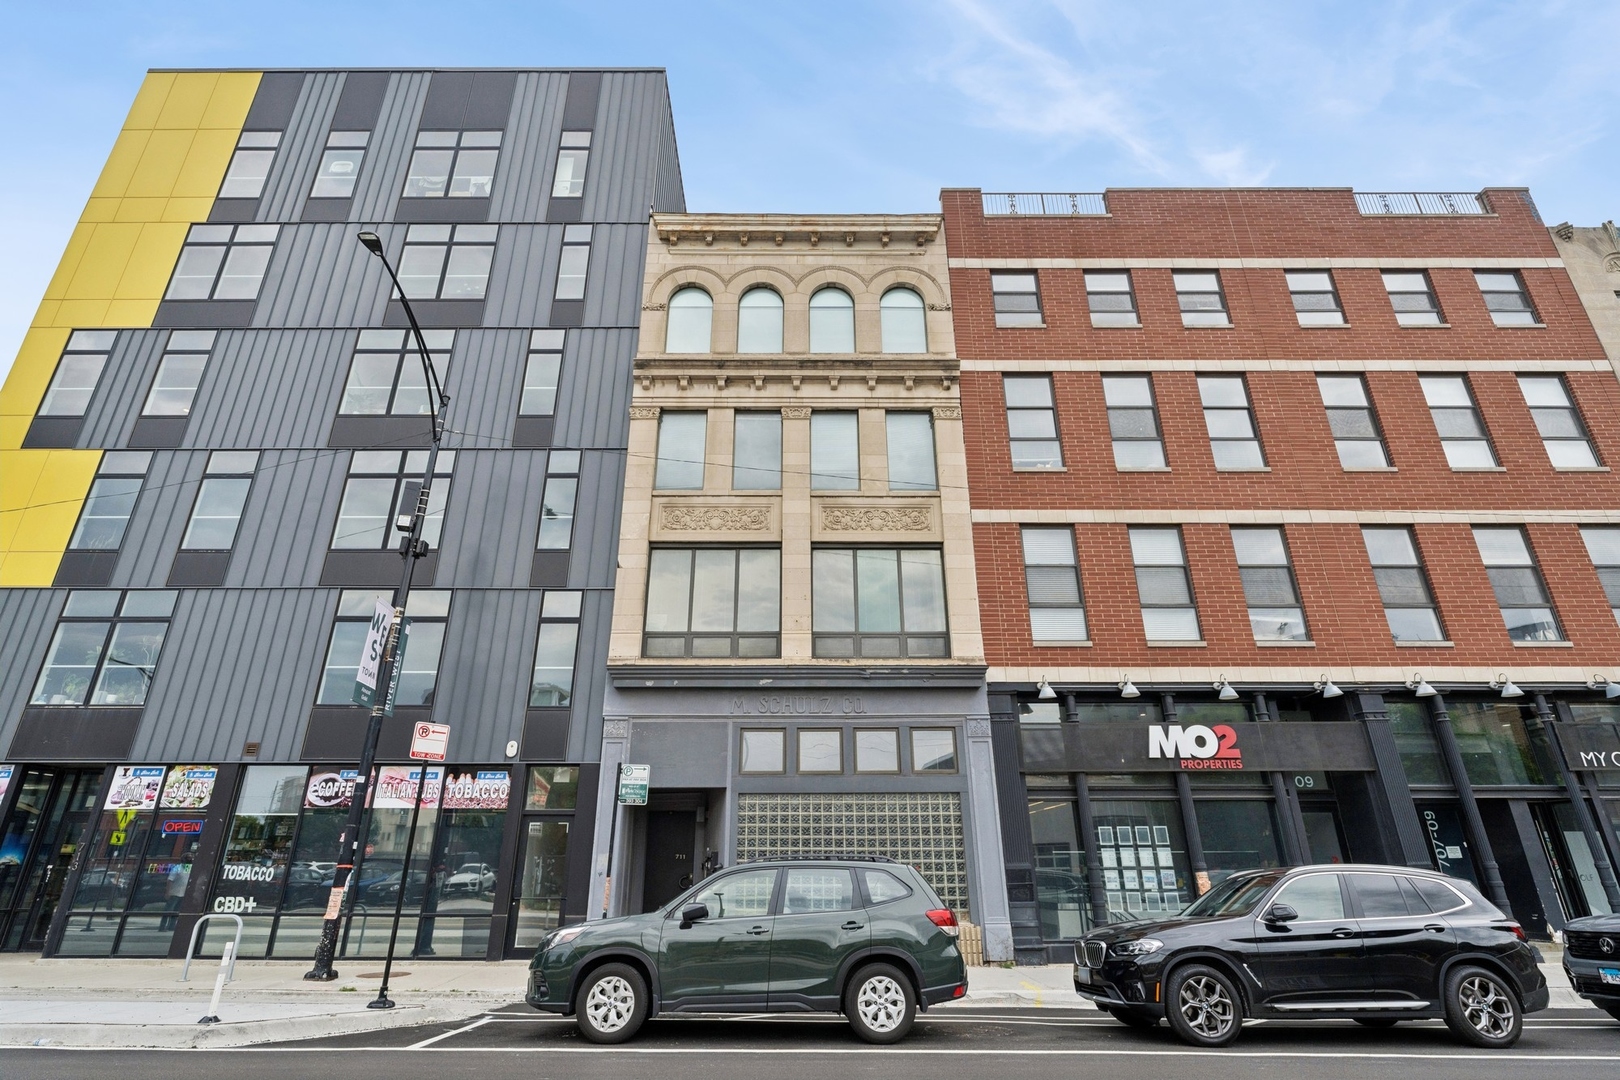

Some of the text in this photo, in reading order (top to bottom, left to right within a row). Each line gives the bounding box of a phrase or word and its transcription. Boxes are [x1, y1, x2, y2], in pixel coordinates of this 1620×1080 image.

[384, 680, 396, 711] RIVER
[729, 696, 867, 714] M. SCHULZ CO.
[1149, 725, 1241, 759] MO2
[1181, 759, 1243, 769] PROPERTIES
[1579, 751, 1606, 768] MY
[318, 781, 357, 797] COFFE
[1294, 775, 1314, 788] 09
[171, 782, 209, 798] SALADS
[376, 782, 413, 798] ITALIAN
[447, 783, 508, 799] TOBACCO
[164, 821, 201, 833] OPEN
[71, 842, 86, 871] 713
[222, 865, 275, 882] TOBACCO
[213, 896, 257, 913] CBD+
